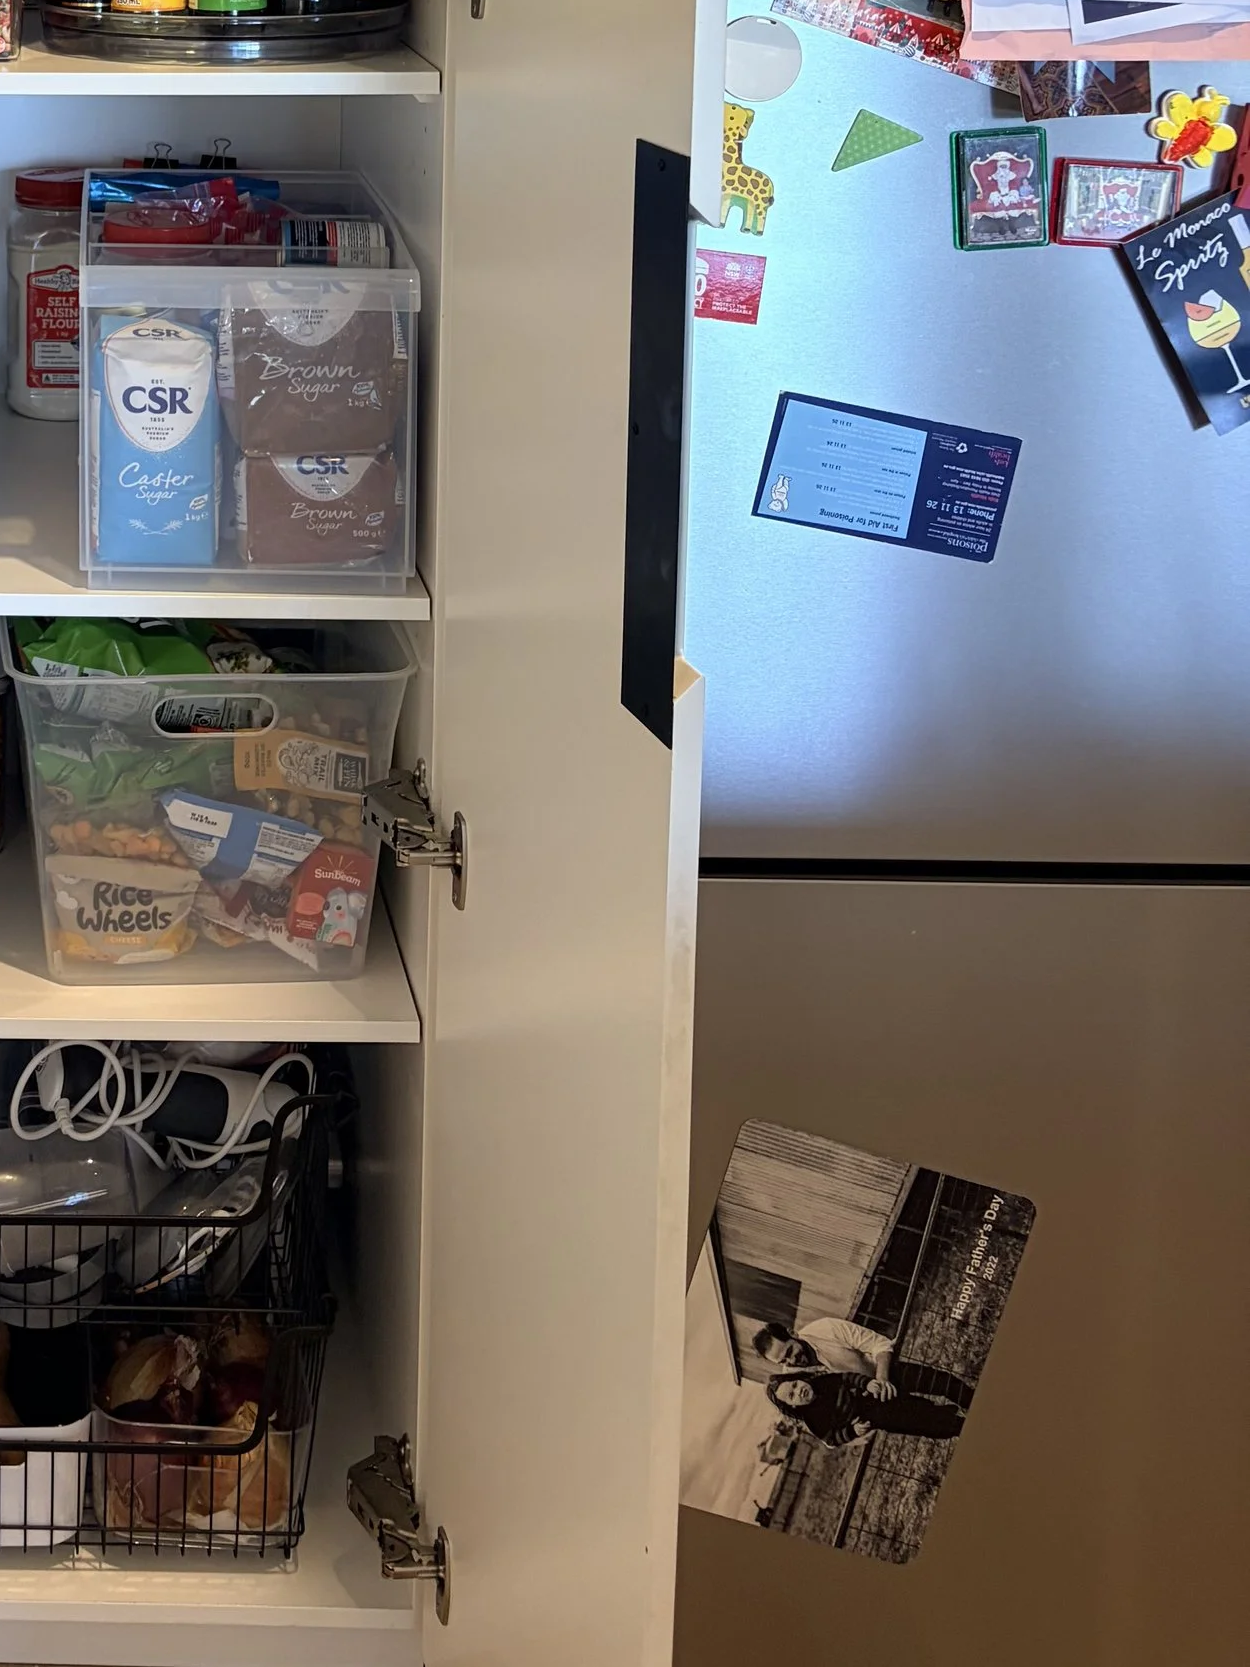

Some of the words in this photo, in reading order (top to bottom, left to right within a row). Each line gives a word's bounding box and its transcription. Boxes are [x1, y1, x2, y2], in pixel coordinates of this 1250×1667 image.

[1137, 245, 1161, 270] Le
[1164, 202, 1232, 248] Monaco
[1155, 234, 1229, 293] Spritz
[48, 297, 76, 307] SELF
[36, 307, 79, 317] RAISIN
[42, 319, 80, 329] FLOUR
[132, 328, 181, 338] CSR
[259, 356, 361, 380] Brown
[288, 378, 341, 402] Sugar
[122, 386, 193, 414] CSR
[296, 456, 350, 475] CSR
[119, 462, 194, 488] Caster
[135, 486, 178, 506] Sugar
[926, 500, 938, 509] 26
[290, 502, 358, 519] Brown
[941, 502, 950, 511] 11
[953, 505, 963, 514] 13
[967, 508, 995, 521] Phone:
[819, 508, 854, 523] Poisoning
[856, 516, 866, 525] for
[867, 519, 881, 527] Aid
[937, 517, 956, 525] poisoning
[305, 518, 343, 535] Sugar
[882, 522, 899, 532] First
[947, 537, 988, 553] poisons
[312, 756, 320, 776] MIX
[318, 754, 327, 782] TRAIL
[314, 867, 361, 887] Sunbeam
[93, 882, 153, 911] Rice
[77, 906, 172, 932] Wheels
[109, 936, 142, 944] CHEESE
[951, 1270, 978, 1320] Happy
[966, 1215, 995, 1269] Father's
[984, 1193, 1005, 1219] Day
[983, 1255, 999, 1282] 2022
